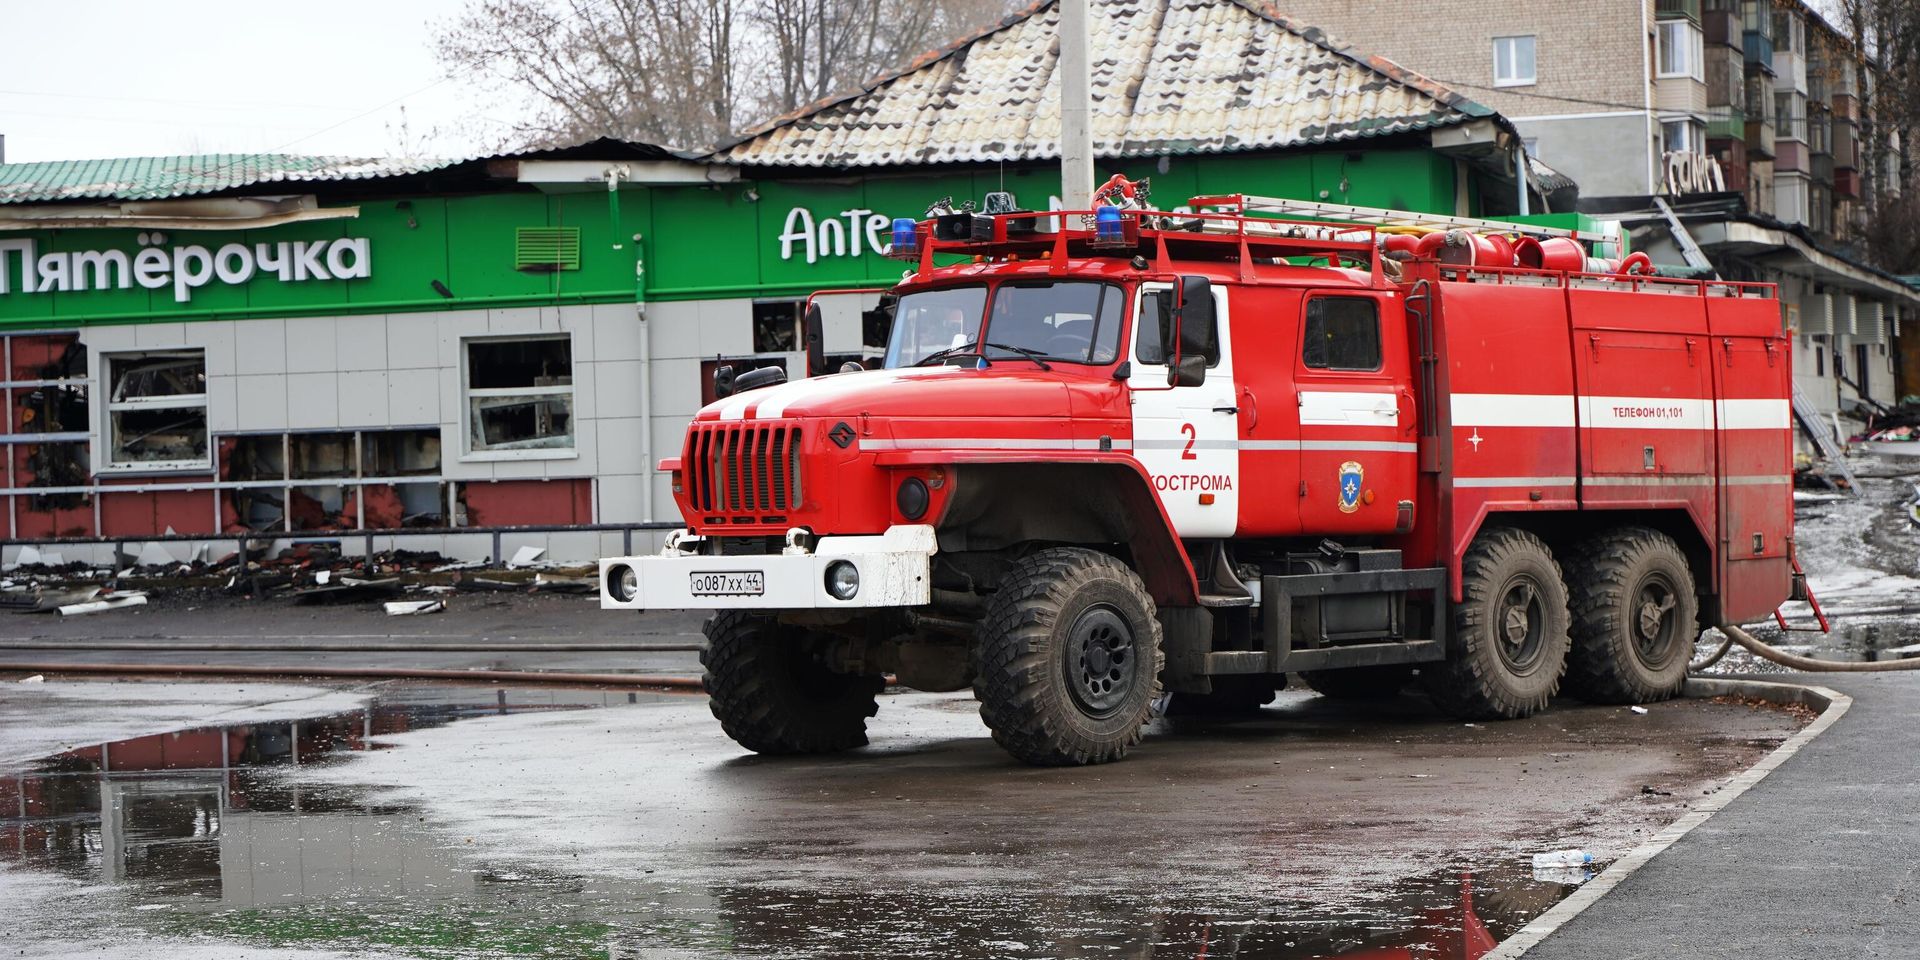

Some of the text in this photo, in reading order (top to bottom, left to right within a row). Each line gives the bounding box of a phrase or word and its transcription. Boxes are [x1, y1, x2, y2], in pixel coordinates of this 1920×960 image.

[778, 207, 893, 264] Апте
[0, 232, 371, 303] Пятёрочка
[1613, 407, 1683, 420] ТЕЛЕФОН 01,101
[1181, 423, 1197, 460] 2
[746, 574, 758, 586] 44
